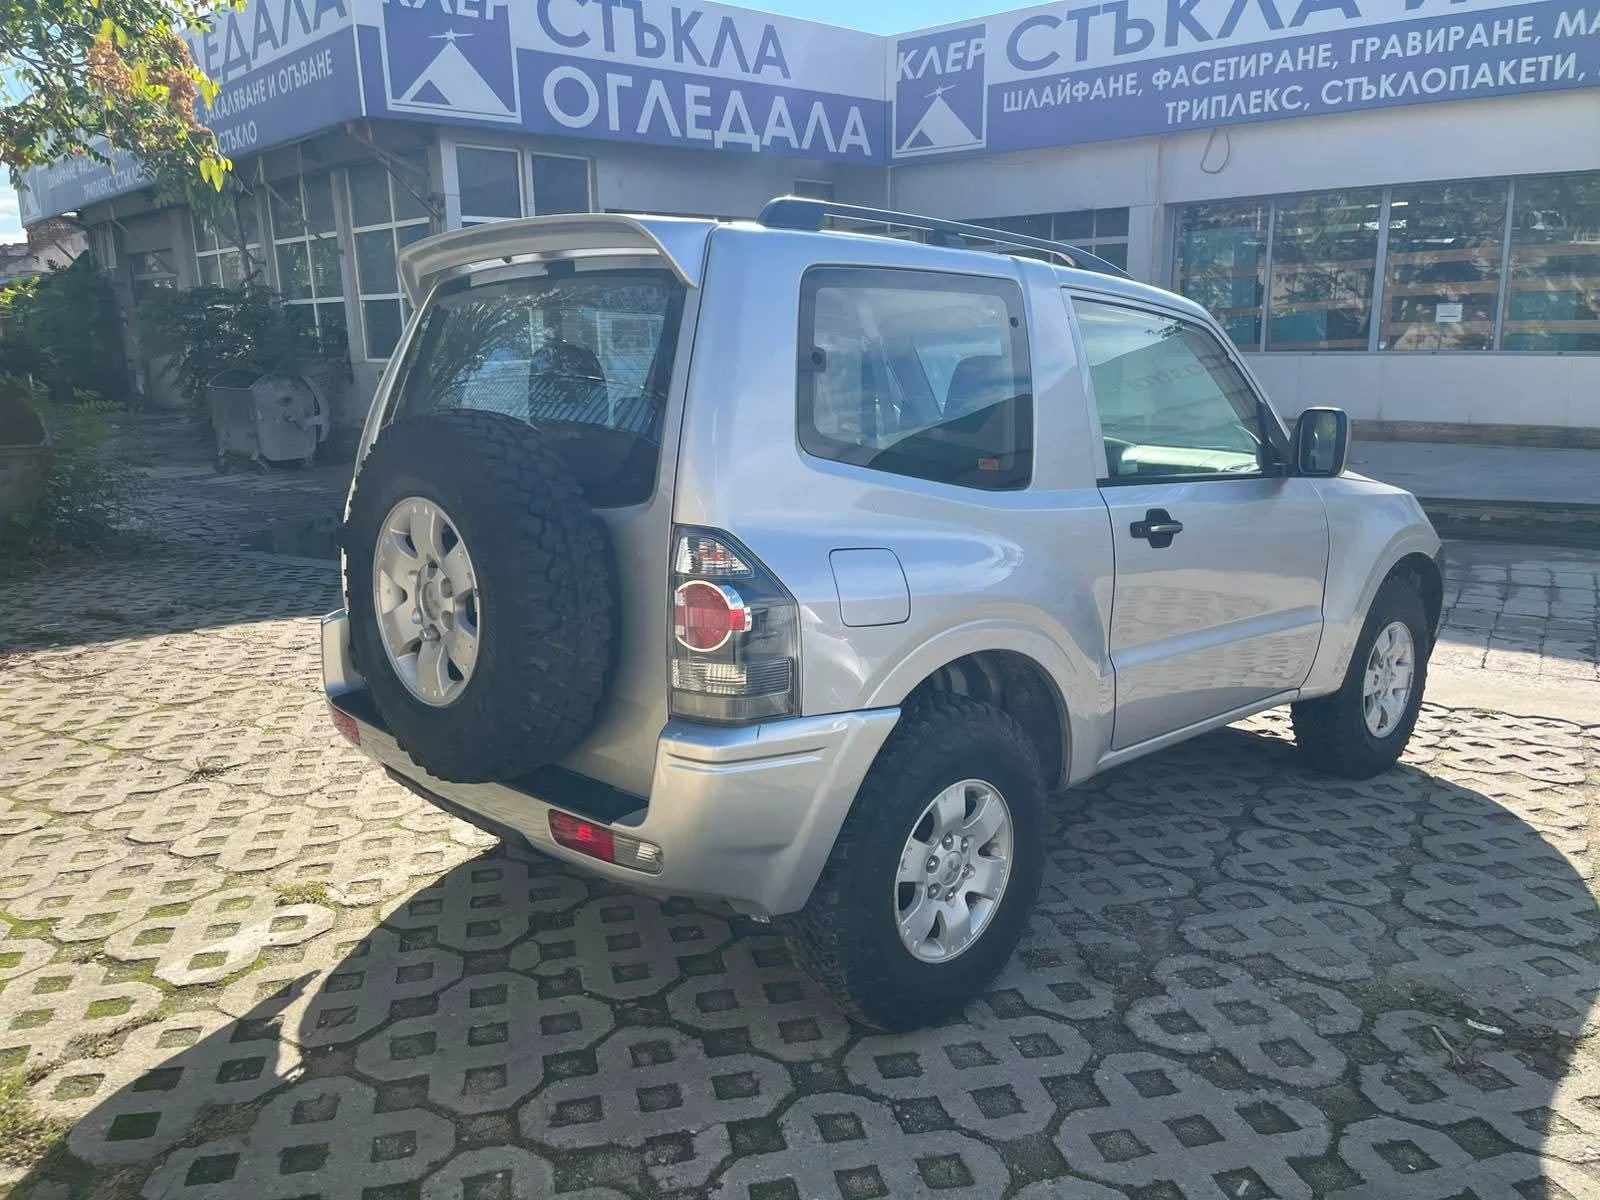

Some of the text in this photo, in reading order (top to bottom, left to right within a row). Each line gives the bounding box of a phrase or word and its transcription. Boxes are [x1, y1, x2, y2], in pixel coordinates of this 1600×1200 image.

[268, 74, 277, 98] И
[278, 49, 333, 93] ОГЪВАНЕ
[537, 0, 793, 81] СТЪКЛА
[896, 37, 985, 81] КЛЕР
[1003, 72, 1143, 113] ШЛАЙФАНЕ,
[1151, 43, 1339, 91] ФАСЕТИРАНЕ,
[1350, 16, 1543, 64] ГРАВИРАНЕ,
[542, 65, 872, 156] ОГЛЕДАЛА
[1165, 52, 1586, 125] ТРИПЛЕКС, СТЪКЛОПАКЕТИ,
